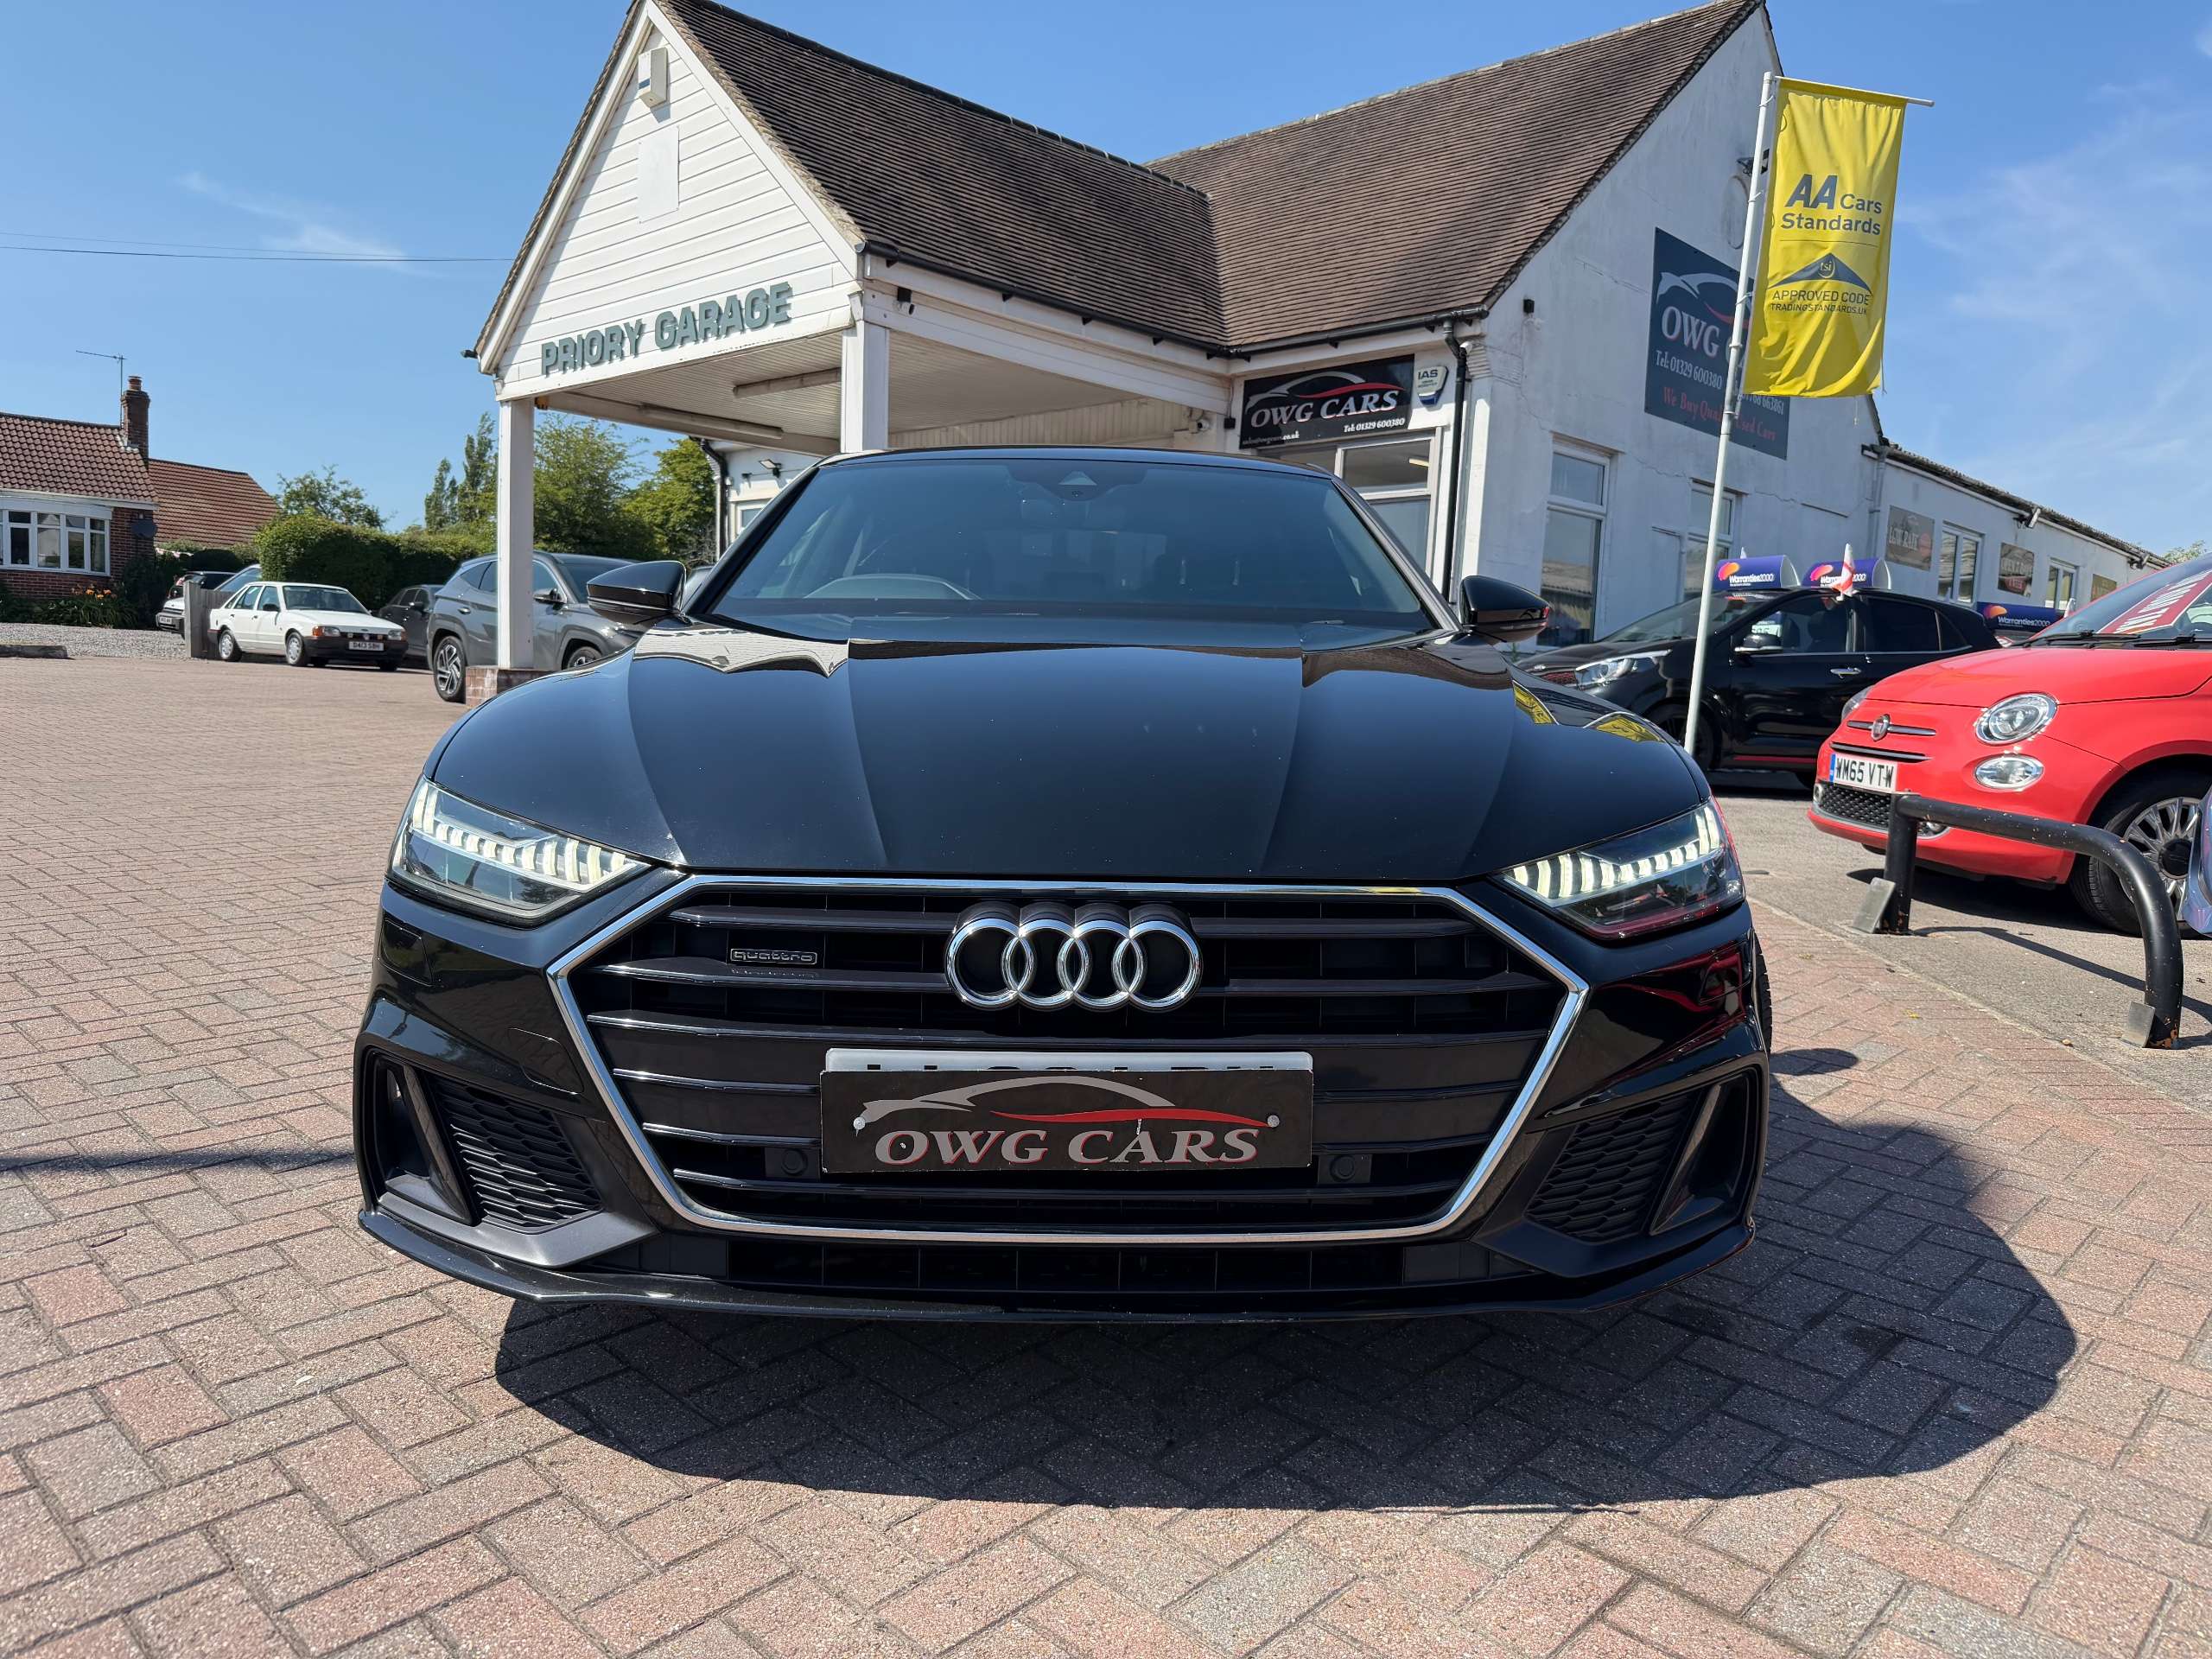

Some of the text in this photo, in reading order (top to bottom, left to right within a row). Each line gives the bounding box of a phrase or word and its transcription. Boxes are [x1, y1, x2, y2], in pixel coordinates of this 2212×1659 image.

[1784, 173, 1883, 214] AA Cars
[1781, 213, 1881, 236] Standards
[1772, 289, 1871, 305] APPROVED CODE
[541, 281, 793, 378] PRIORY GARAGE
[1661, 306, 1720, 359] OWG
[1418, 369, 1439, 380] IAS
[1656, 350, 1669, 369] Tel:
[1670, 356, 1693, 378] 01329
[1693, 365, 1723, 390] 600380
[1251, 390, 1400, 428] OWG CARS
[1663, 387, 1677, 407] We
[1680, 392, 1699, 420] Buy
[1356, 421, 1376, 431] 01329
[1376, 417, 1406, 429] 600380
[1998, 615, 2050, 627] Warranties2000
[1836, 757, 1894, 788] WM65 VTW
[734, 950, 813, 962] quattro
[874, 1128, 1259, 1166] OWG CARS
